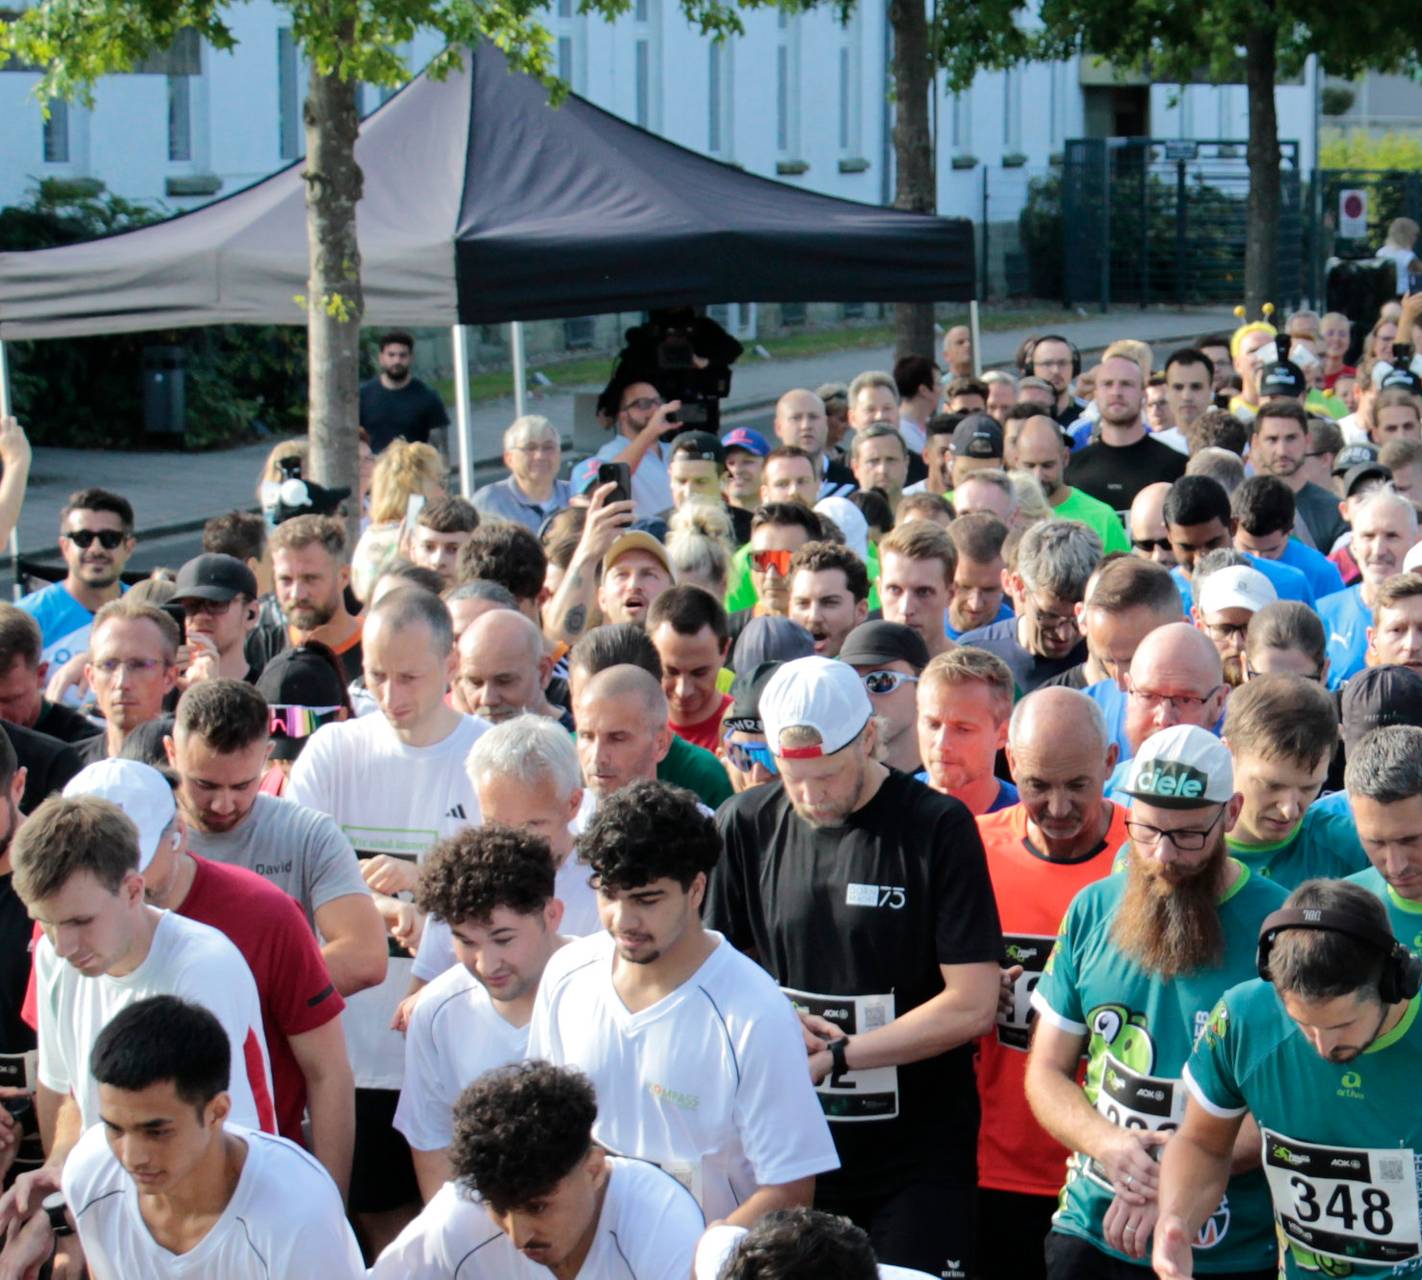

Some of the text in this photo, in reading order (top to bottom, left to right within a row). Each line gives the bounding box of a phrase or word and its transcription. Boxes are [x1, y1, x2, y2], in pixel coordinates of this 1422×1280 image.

[1138, 767, 1203, 798] ciele
[255, 859, 293, 876] David
[1330, 1158, 1351, 1168] AOK
[1290, 1175, 1394, 1236] 348
